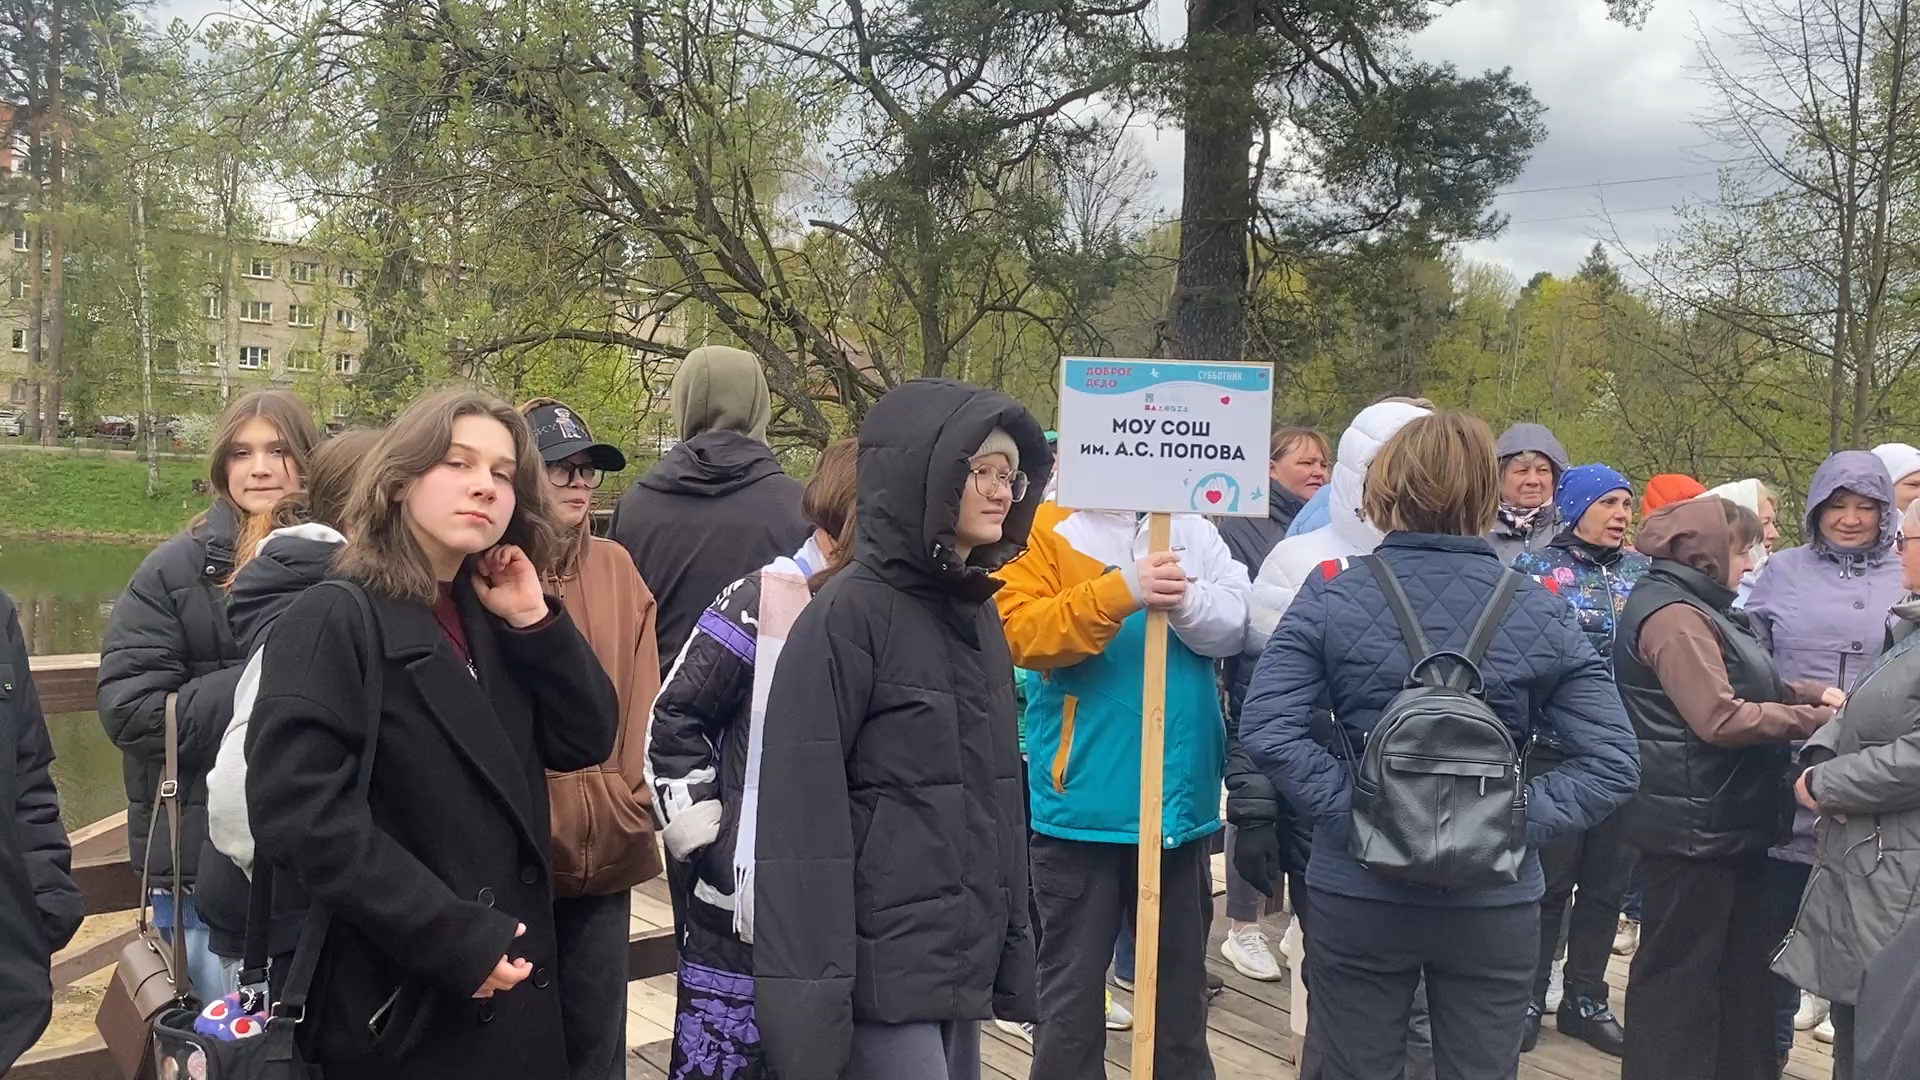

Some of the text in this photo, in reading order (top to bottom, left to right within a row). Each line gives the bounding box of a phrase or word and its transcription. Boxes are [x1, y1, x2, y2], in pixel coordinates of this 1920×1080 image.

[1086, 367, 1132, 376] ДОБРОЕ
[1086, 379, 1117, 388] ДЕЛО
[1112, 418, 1210, 436] МОУ СОШ
[1080, 441, 1246, 461] им. А.С. ПОПОВА
